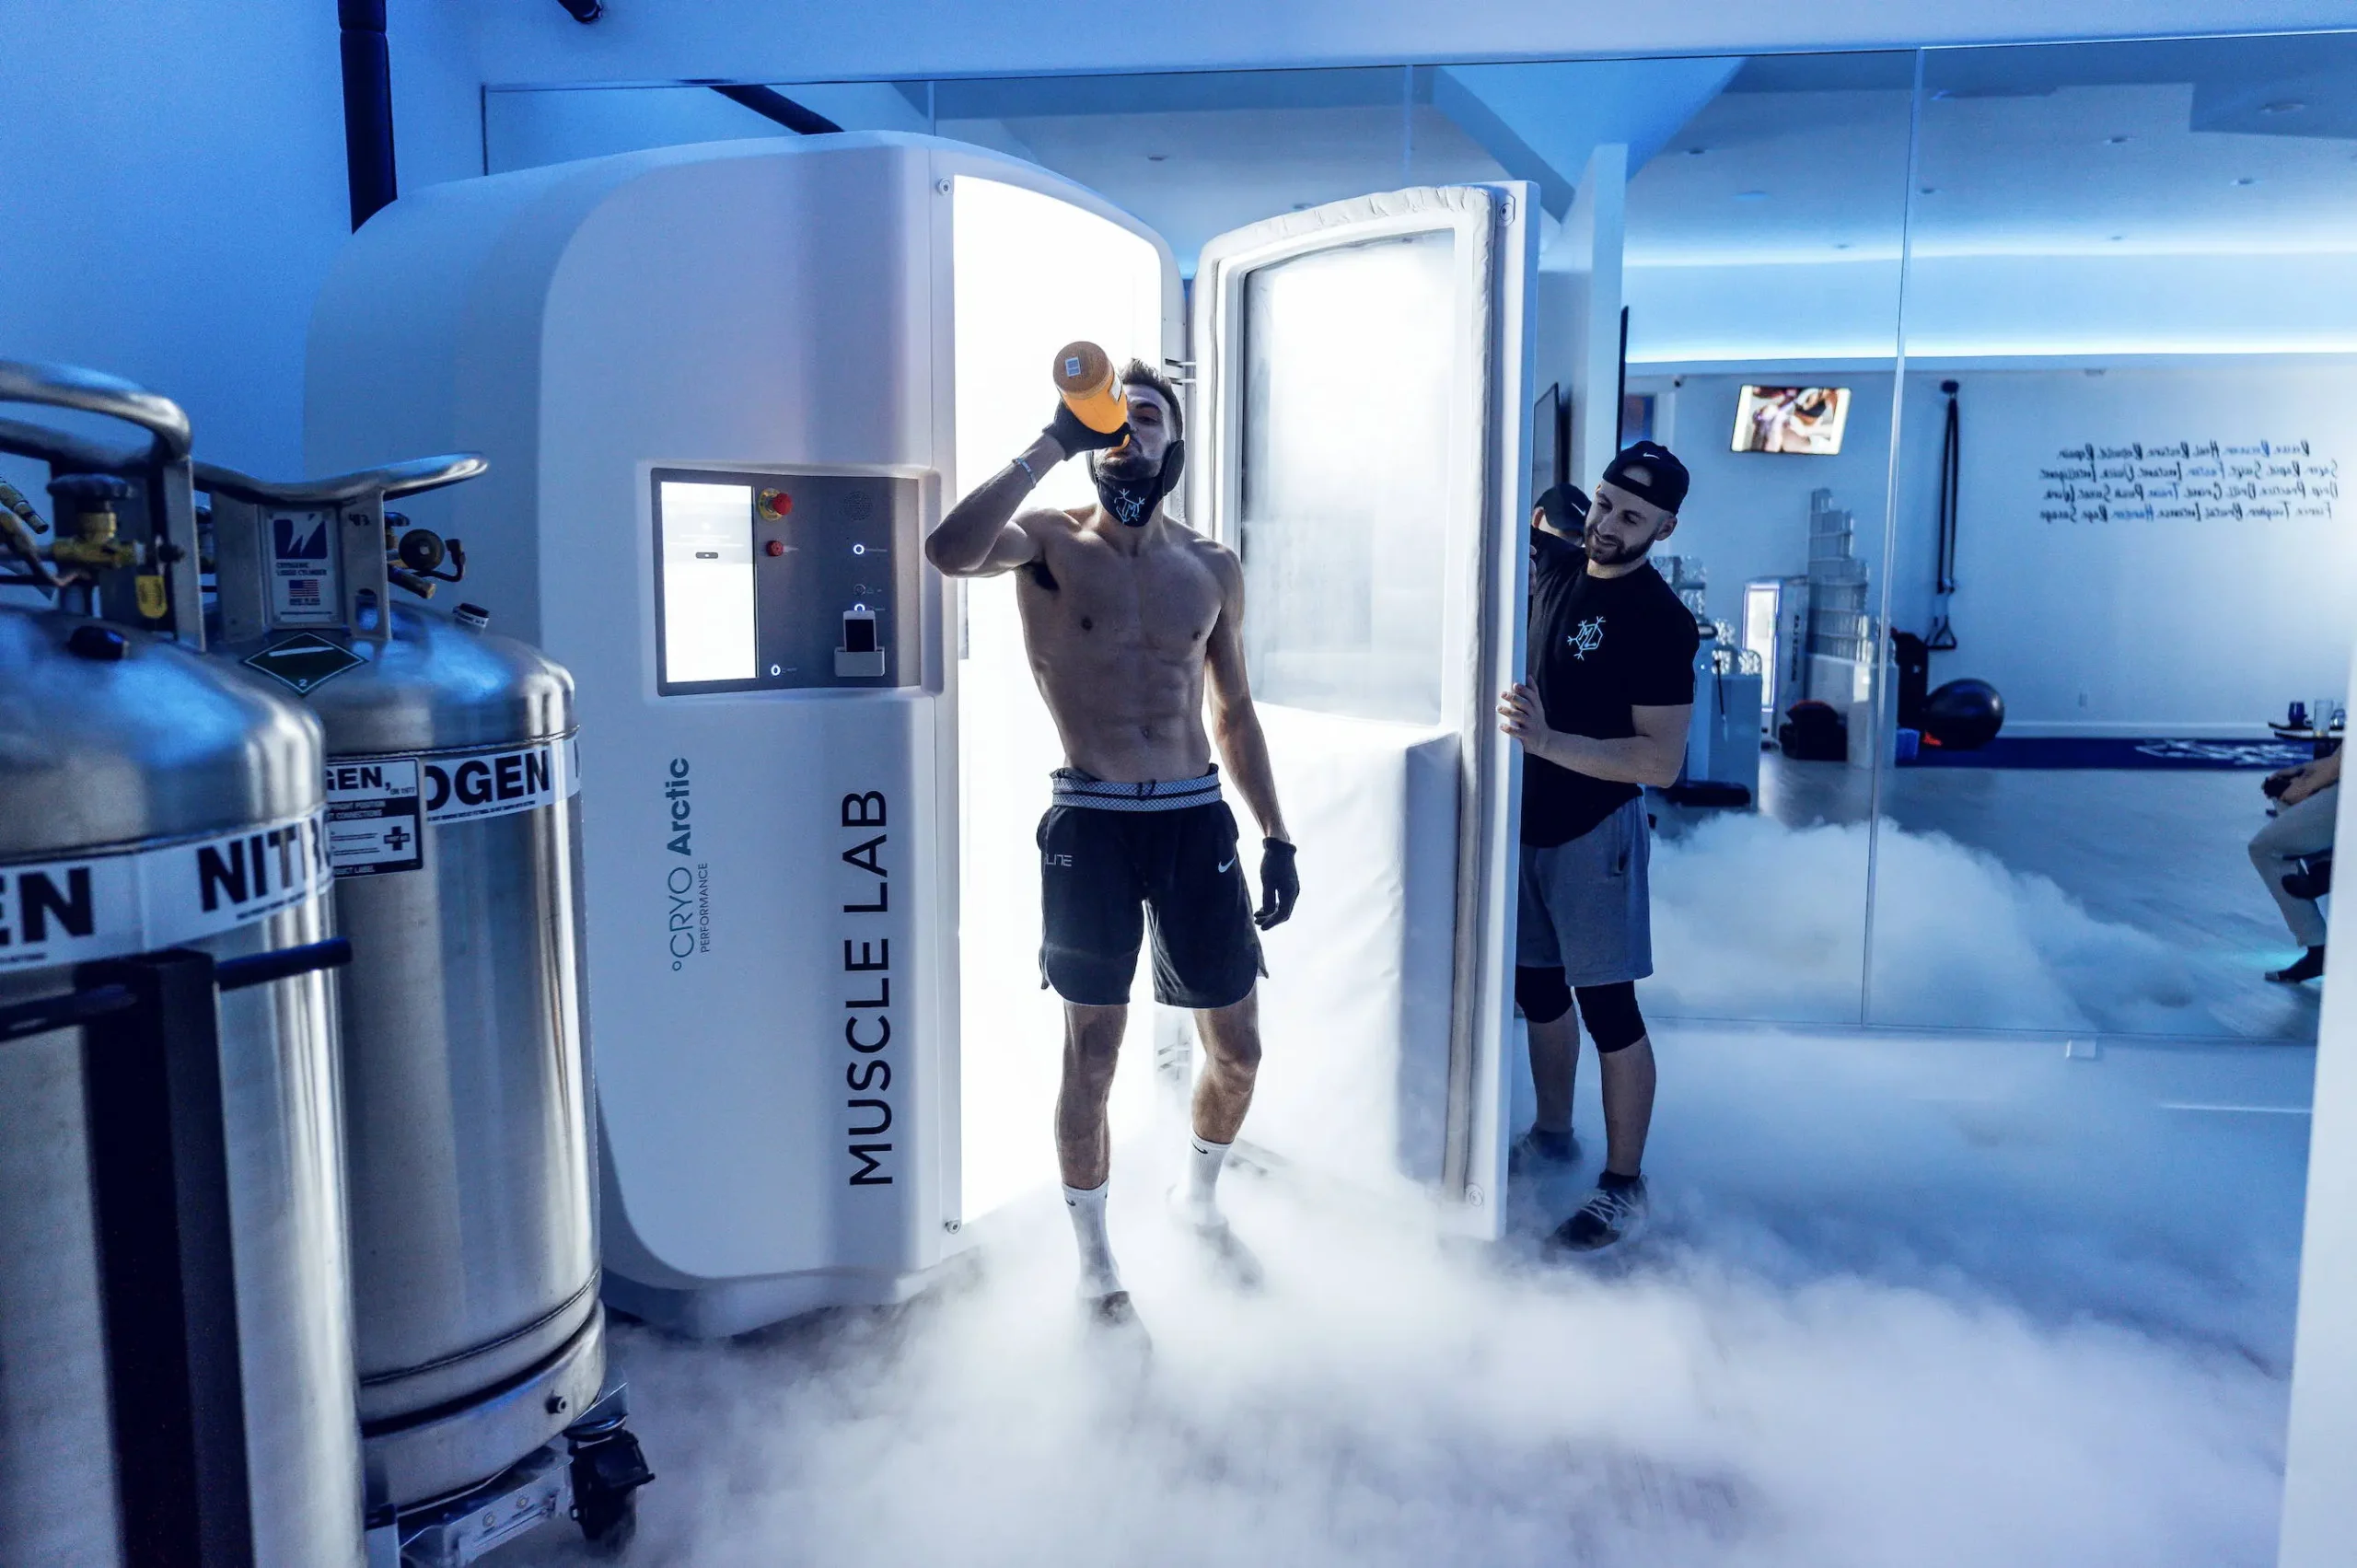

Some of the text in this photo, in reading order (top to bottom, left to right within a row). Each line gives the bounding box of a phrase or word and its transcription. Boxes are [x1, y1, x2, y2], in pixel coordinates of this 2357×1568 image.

[298, 678, 308, 687] 2
[665, 756, 691, 856] Arctic
[700, 862, 711, 954] PERFORMANCE
[842, 790, 894, 1185] MUSCLE LAB
